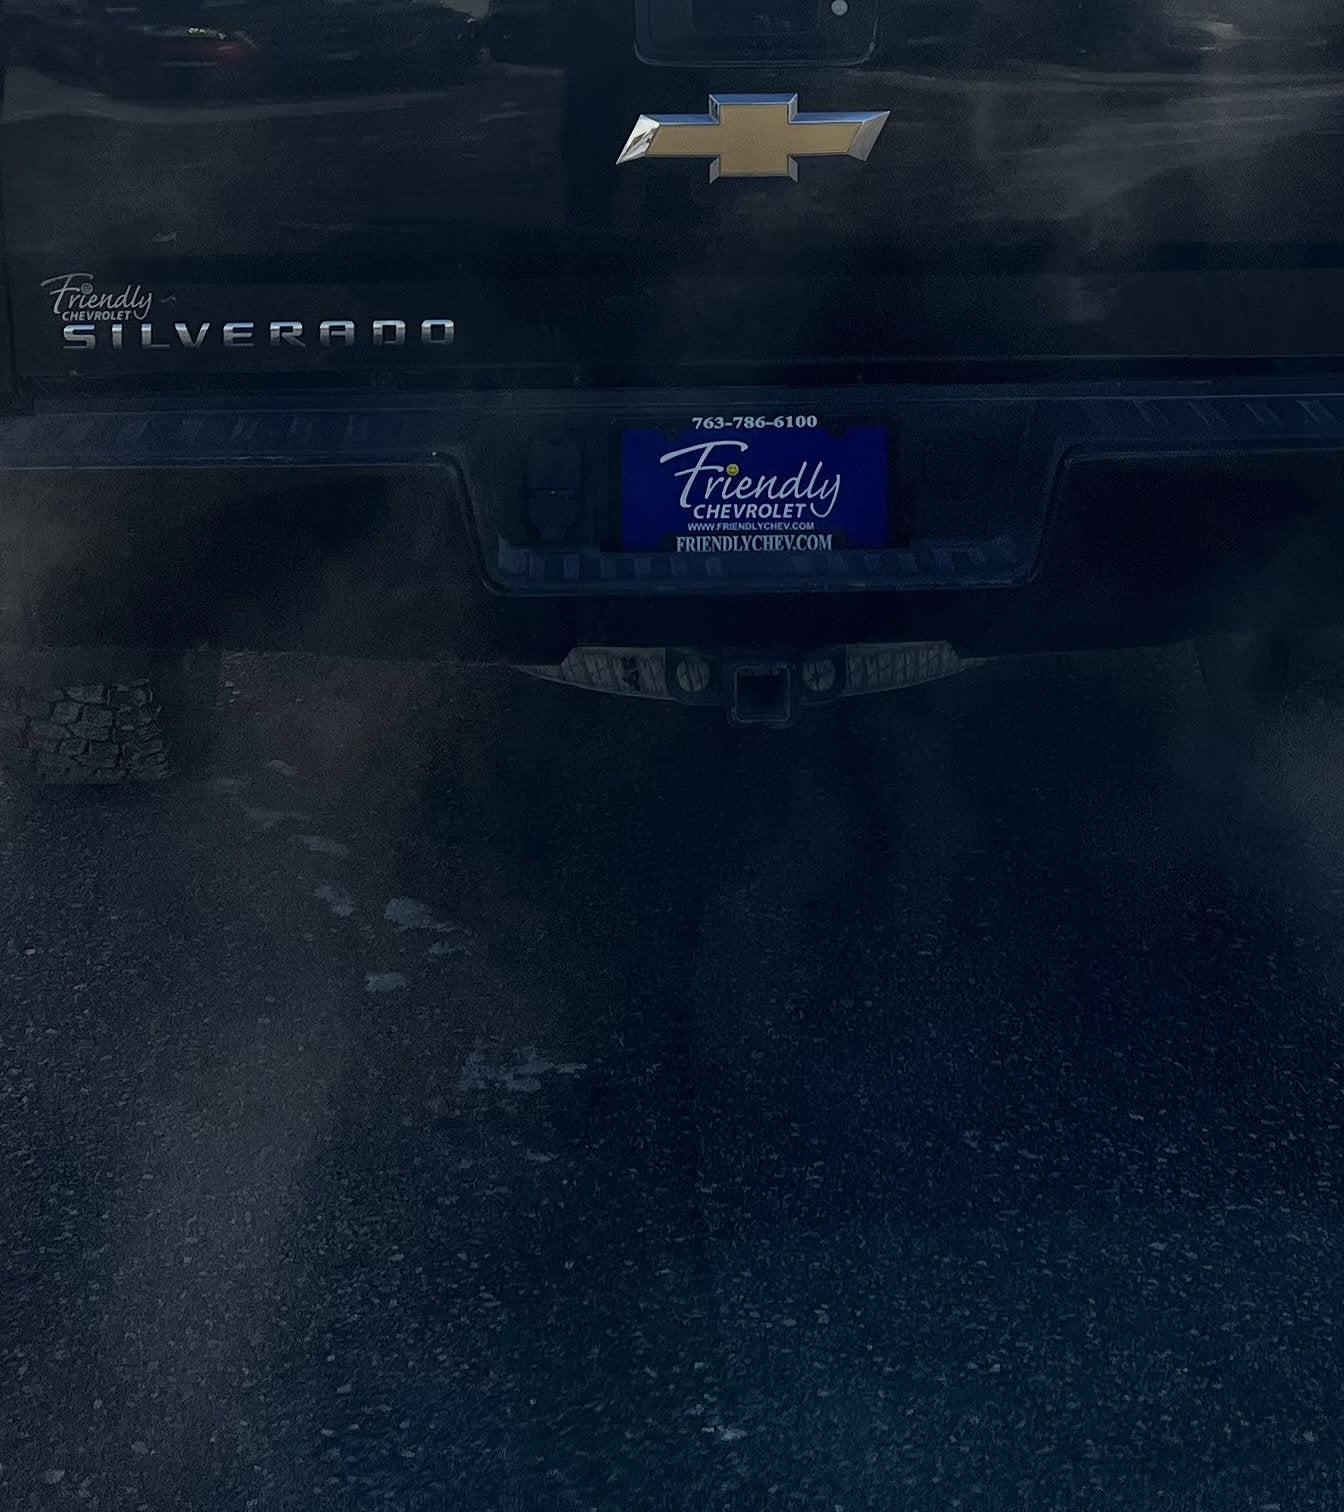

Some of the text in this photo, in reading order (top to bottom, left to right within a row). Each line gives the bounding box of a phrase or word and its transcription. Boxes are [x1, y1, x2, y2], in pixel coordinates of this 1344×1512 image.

[40, 273, 152, 320] Friendly
[61, 310, 132, 321] CHEVROLET
[63, 319, 455, 349] SILVERADO
[692, 415, 818, 429] 763-786-6100
[659, 440, 841, 518] Friendly
[693, 503, 807, 519] CHEVROLET
[687, 521, 815, 531] WWW.FRIENDLYCHEV.COM
[676, 534, 833, 553] FRIENDLYCHEV.COM
